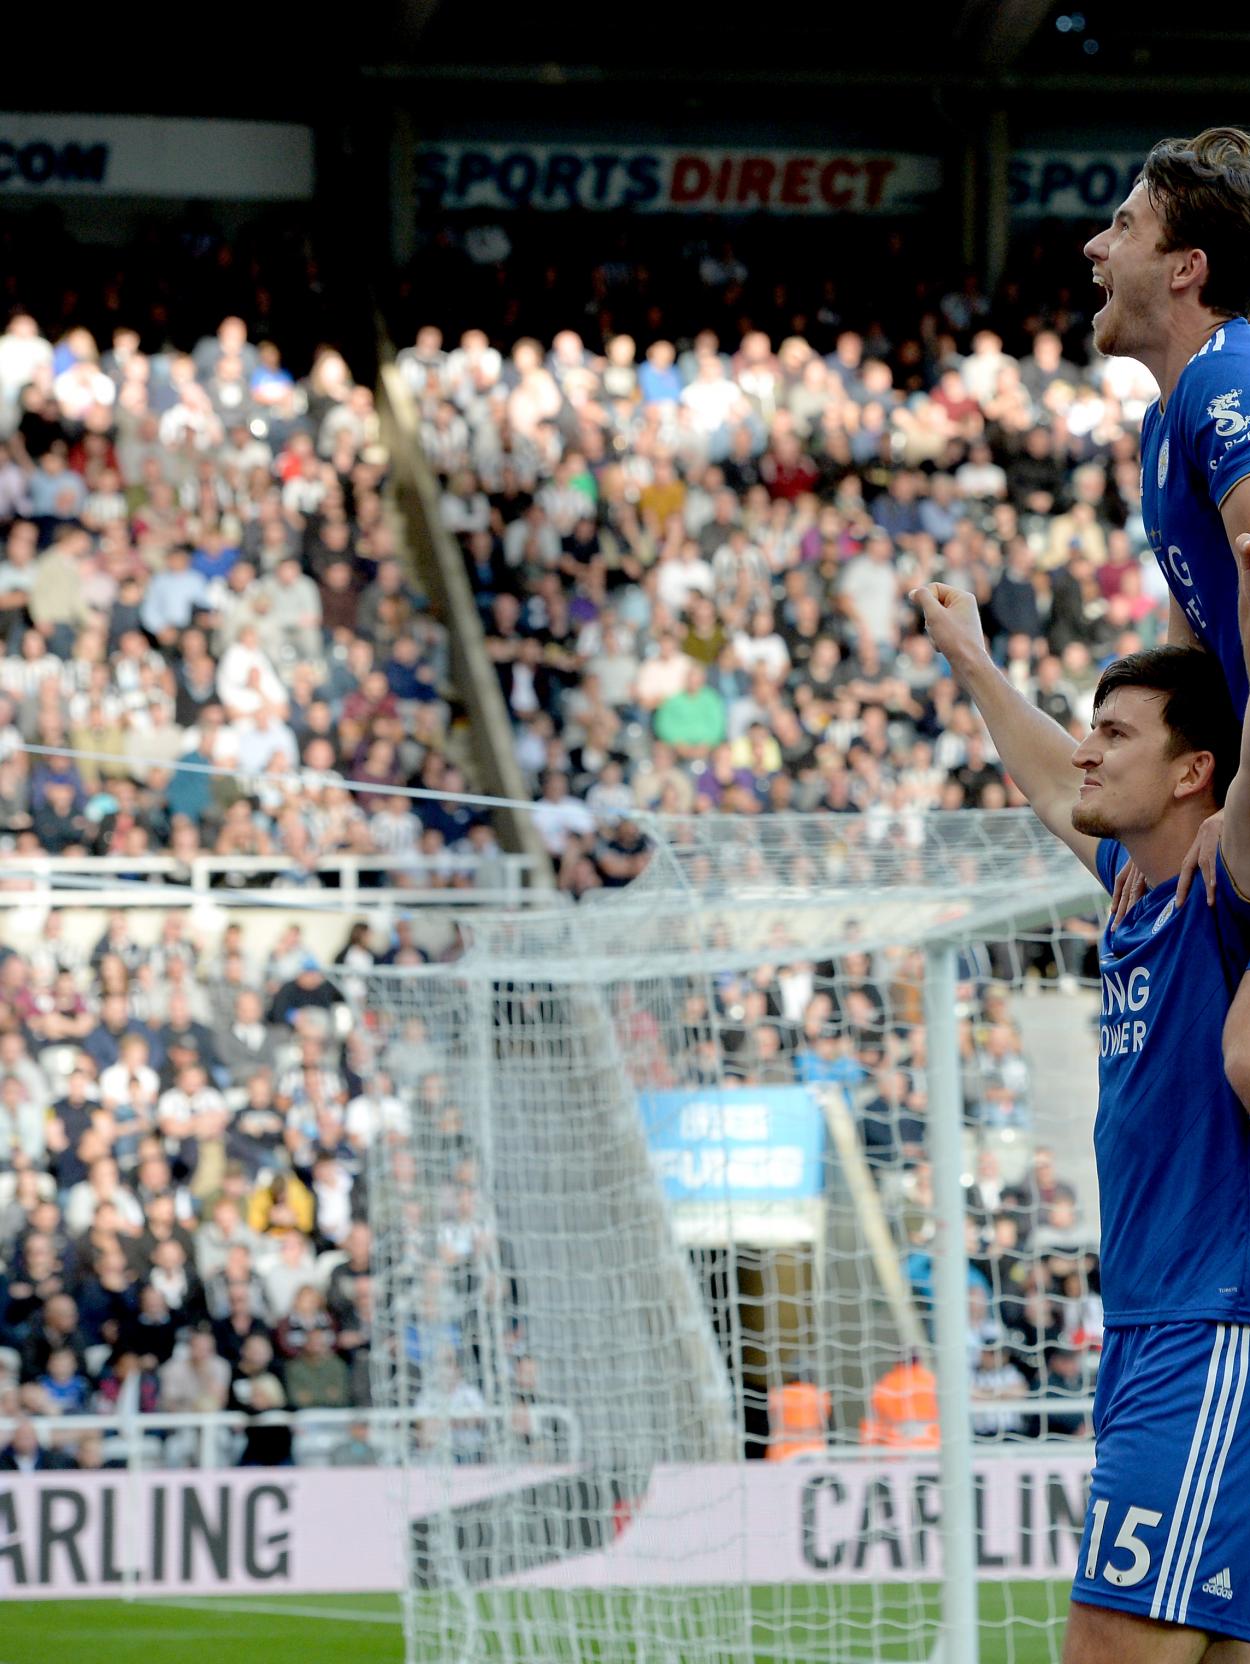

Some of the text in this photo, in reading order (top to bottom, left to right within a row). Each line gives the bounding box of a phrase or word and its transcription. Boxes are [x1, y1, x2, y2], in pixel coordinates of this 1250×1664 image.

[416, 154, 895, 208] SPORTS DIRECT
[1009, 162, 1145, 206] SPO
[1100, 1020, 1147, 1058] OWER
[800, 1472, 1094, 1570] CARLIN
[1084, 1499, 1163, 1587] 15
[1202, 1582, 1233, 1600] adidas
